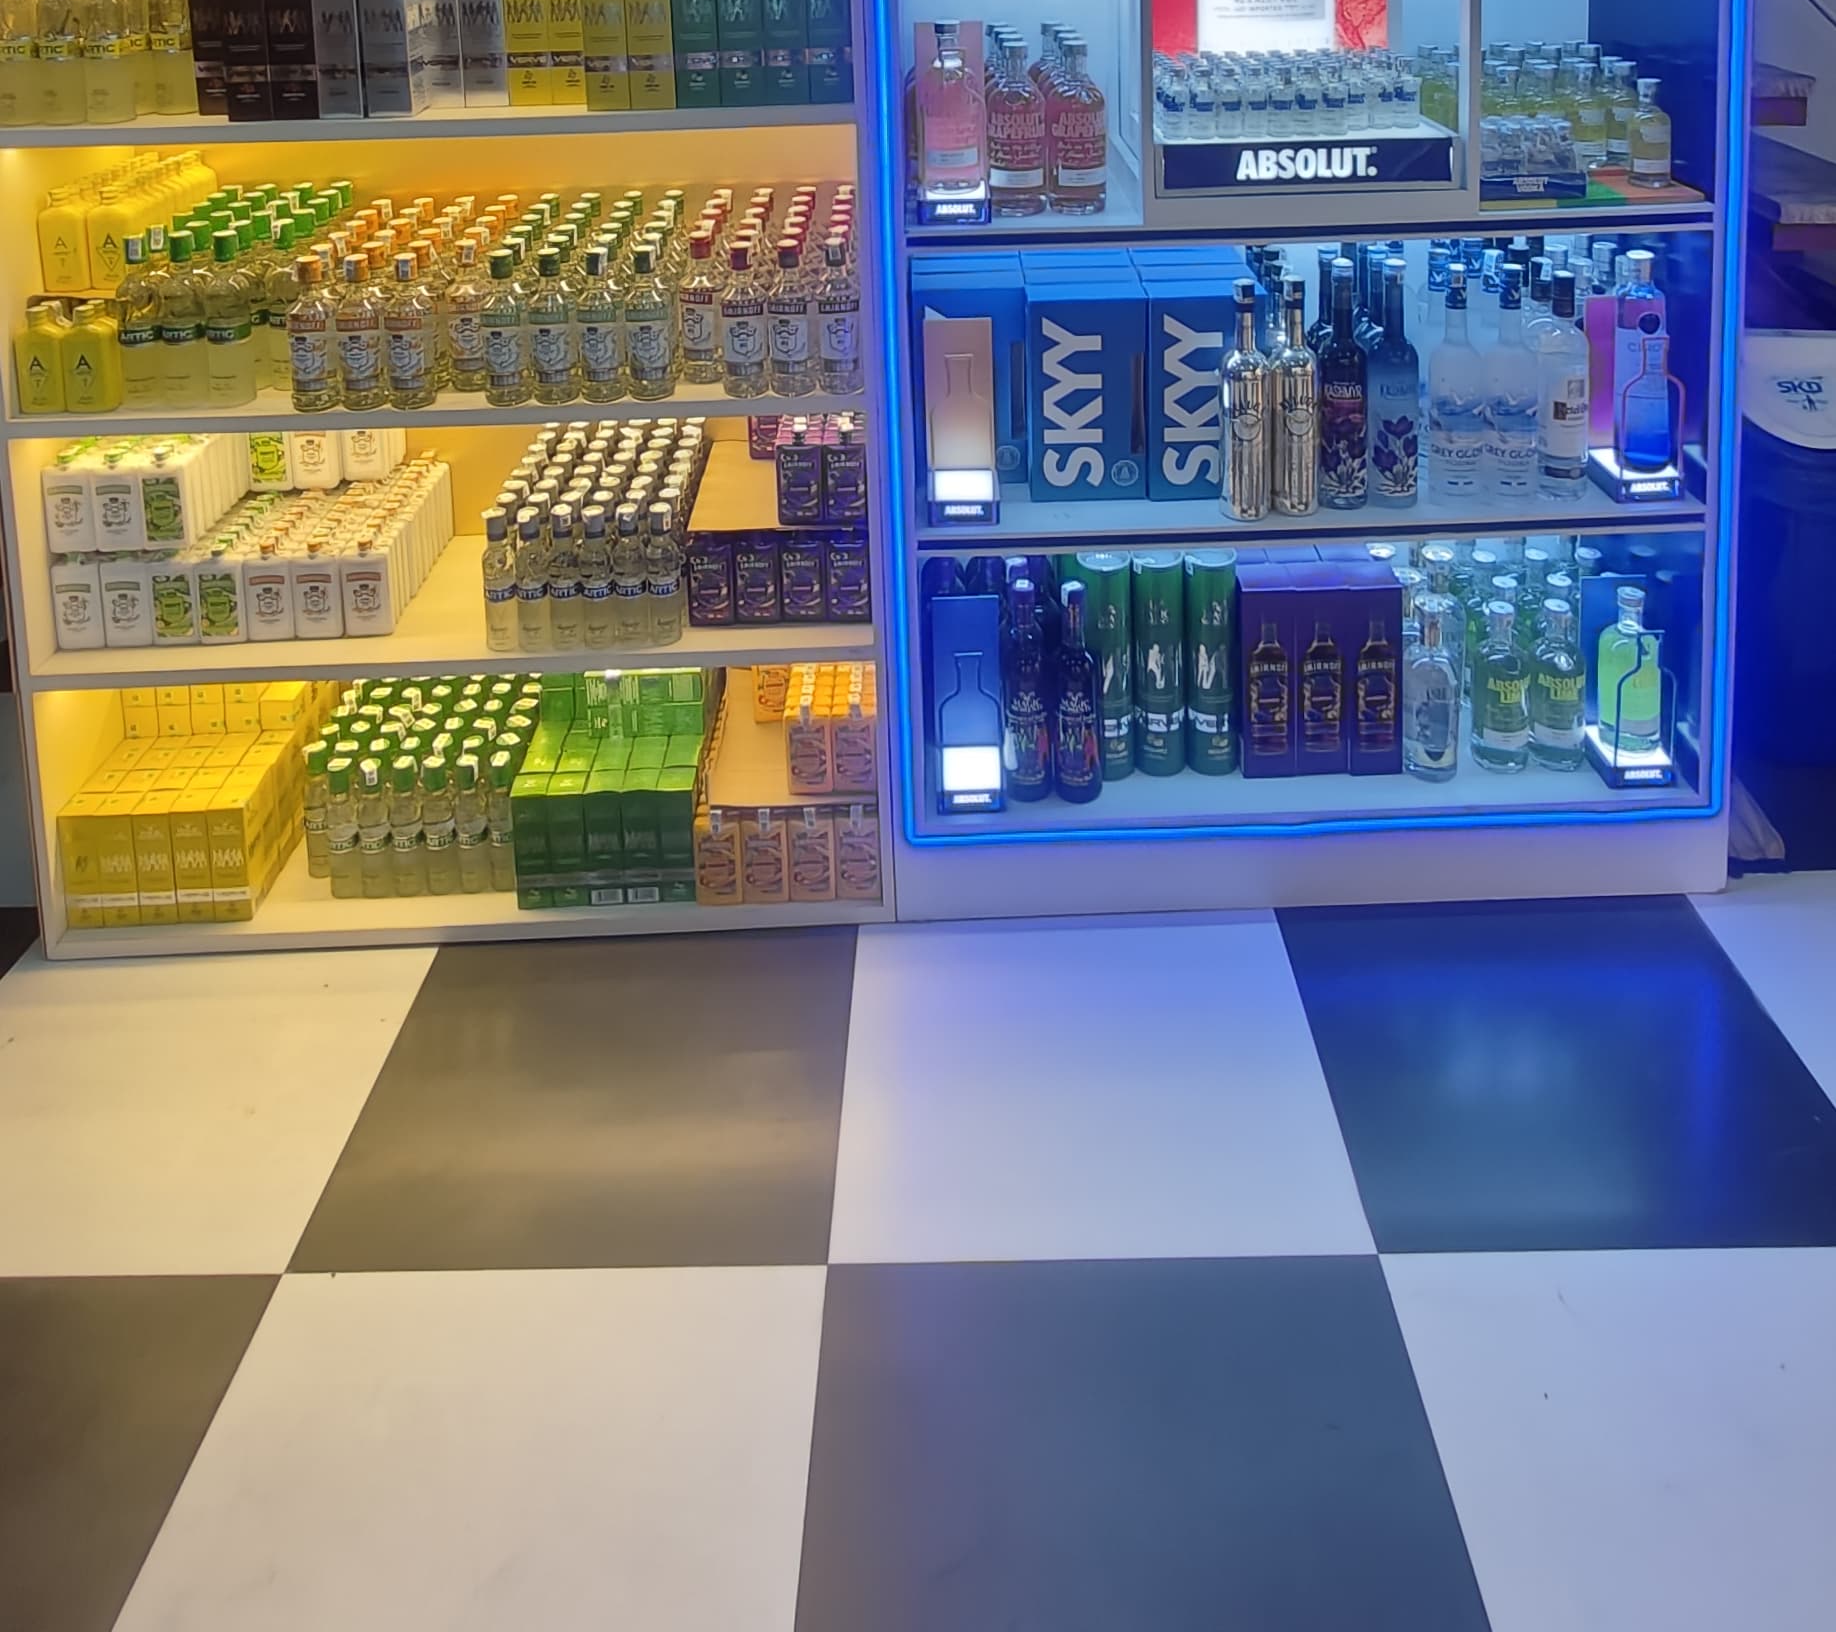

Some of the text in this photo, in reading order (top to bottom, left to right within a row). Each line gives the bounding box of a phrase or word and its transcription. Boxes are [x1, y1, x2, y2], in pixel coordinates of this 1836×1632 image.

[552, 55, 584, 64] VERV
[1041, 316, 1105, 487] SKYY
[1162, 313, 1223, 486] SKYY
